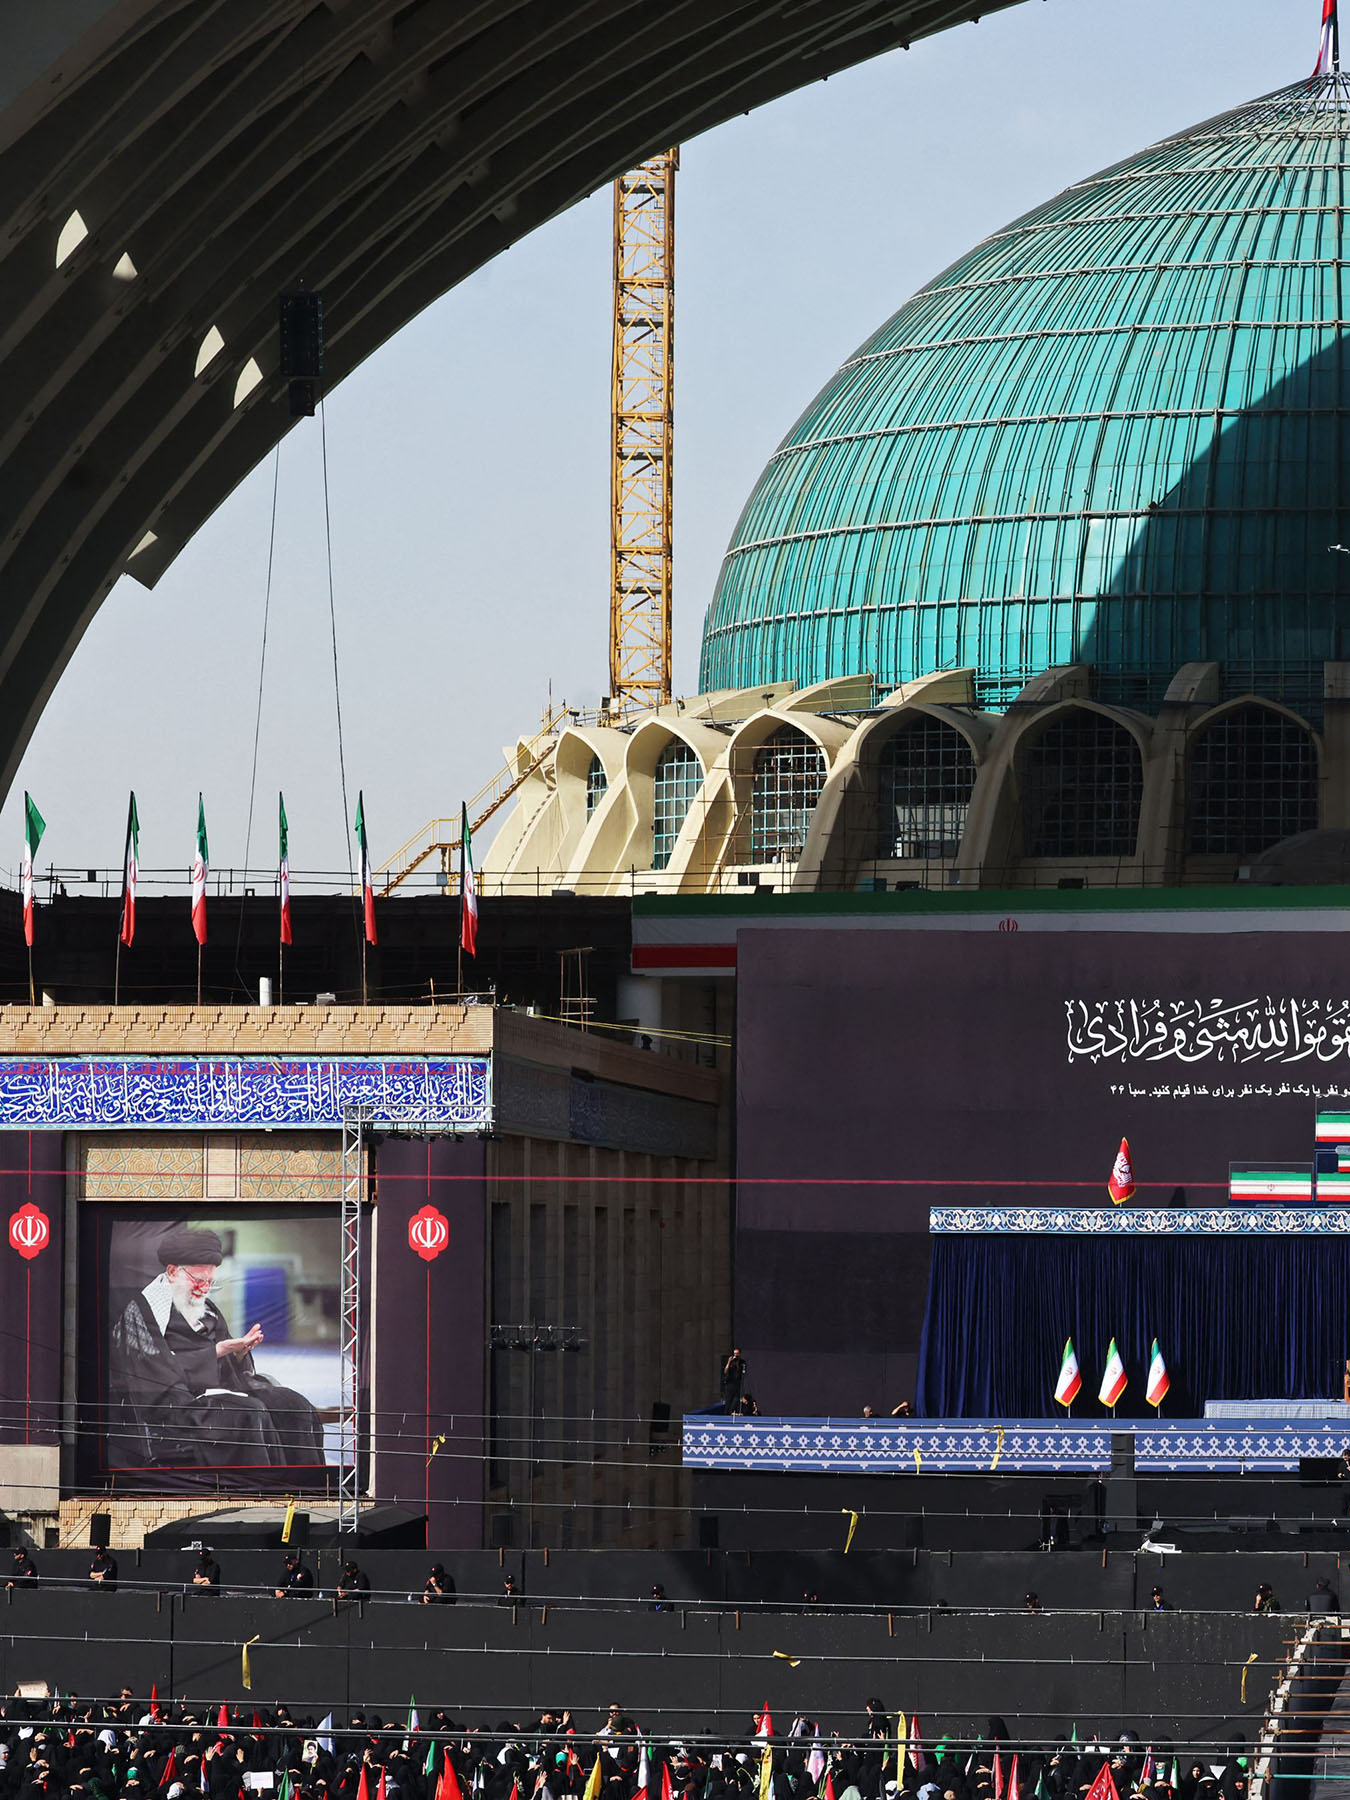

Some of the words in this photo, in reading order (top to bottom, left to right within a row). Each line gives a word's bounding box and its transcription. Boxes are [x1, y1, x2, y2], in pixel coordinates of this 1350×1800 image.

[1110, 1084, 1124, 1095] ۴۶
[1129, 1083, 1146, 1098] سبأ
[1149, 1085, 1170, 1098] کنید.
[1173, 1084, 1190, 1099] قیام
[1193, 1084, 1209, 1095] خدا
[1212, 1084, 1234, 1098] برای
[1237, 1084, 1252, 1098] نفر
[1255, 1084, 1272, 1097] یک
[1275, 1083, 1290, 1097] نفر
[1293, 1084, 1309, 1097] یک
[1311, 1085, 1321, 1099] یا
[1323, 1085, 1339, 1098] نفر
